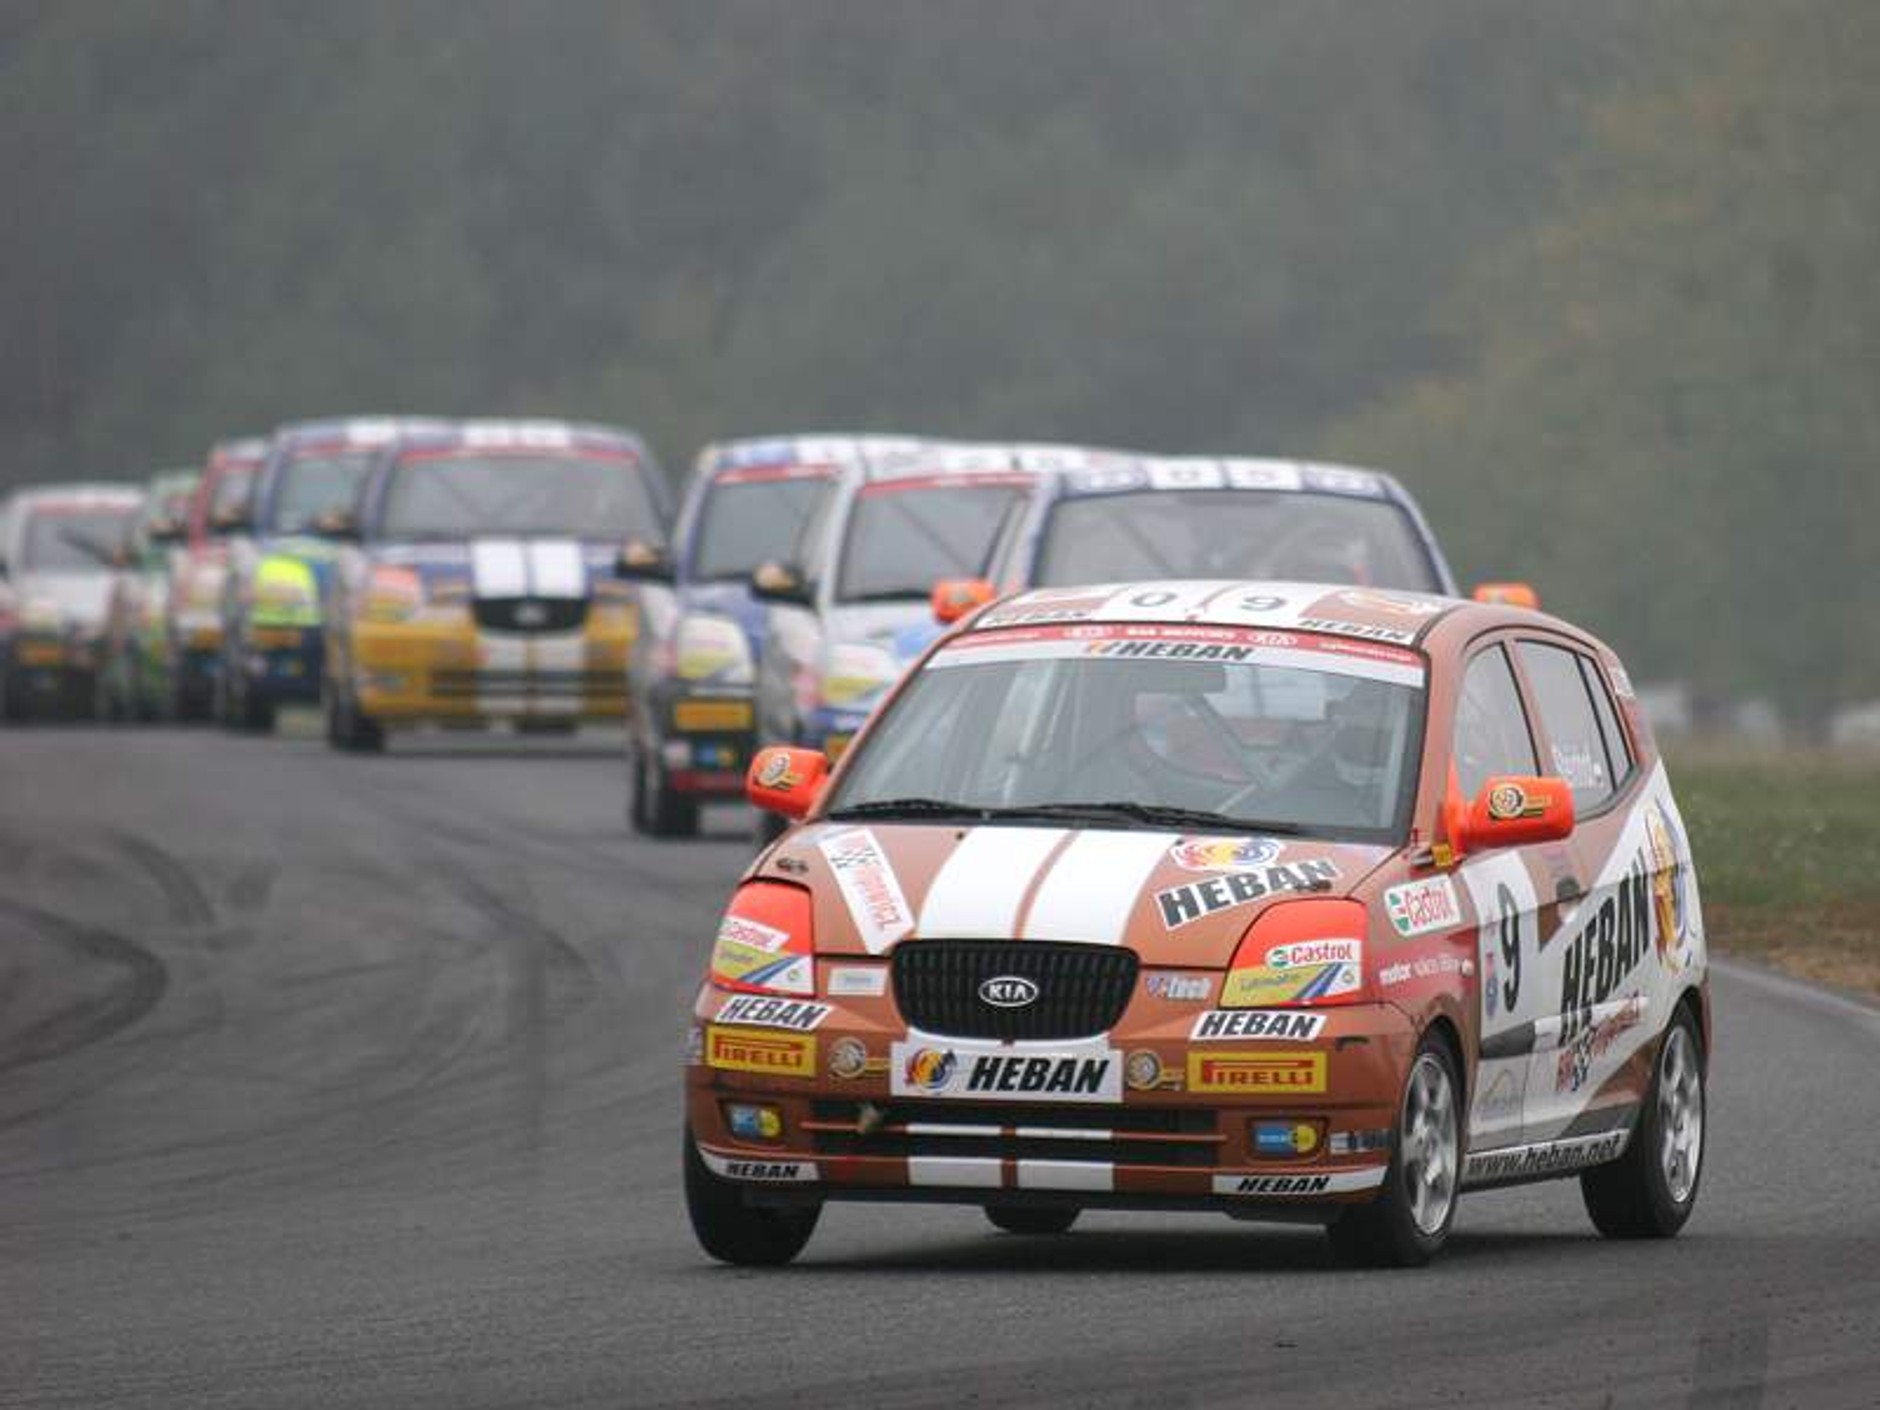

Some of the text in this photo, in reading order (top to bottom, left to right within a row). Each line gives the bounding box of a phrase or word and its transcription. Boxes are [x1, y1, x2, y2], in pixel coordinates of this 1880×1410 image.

[1116, 641, 1254, 661] HEBAN
[1159, 861, 1338, 928] HEBAN
[1291, 943, 1353, 965] Castrol
[1498, 882, 1521, 1013] 9
[1558, 848, 1649, 1048] HEBAN
[988, 984, 1028, 1000] KIA
[720, 998, 828, 1029] HEBAN
[1196, 1013, 1317, 1038] HEBAN
[714, 1034, 804, 1067] PIRELLI
[966, 1055, 1110, 1093] HEBAN
[1202, 1059, 1314, 1084] PIRELLI
[1467, 1133, 1622, 1174] www.heban.net
[726, 1162, 800, 1179] HEBAN
[1237, 1176, 1330, 1193] HEBAN
